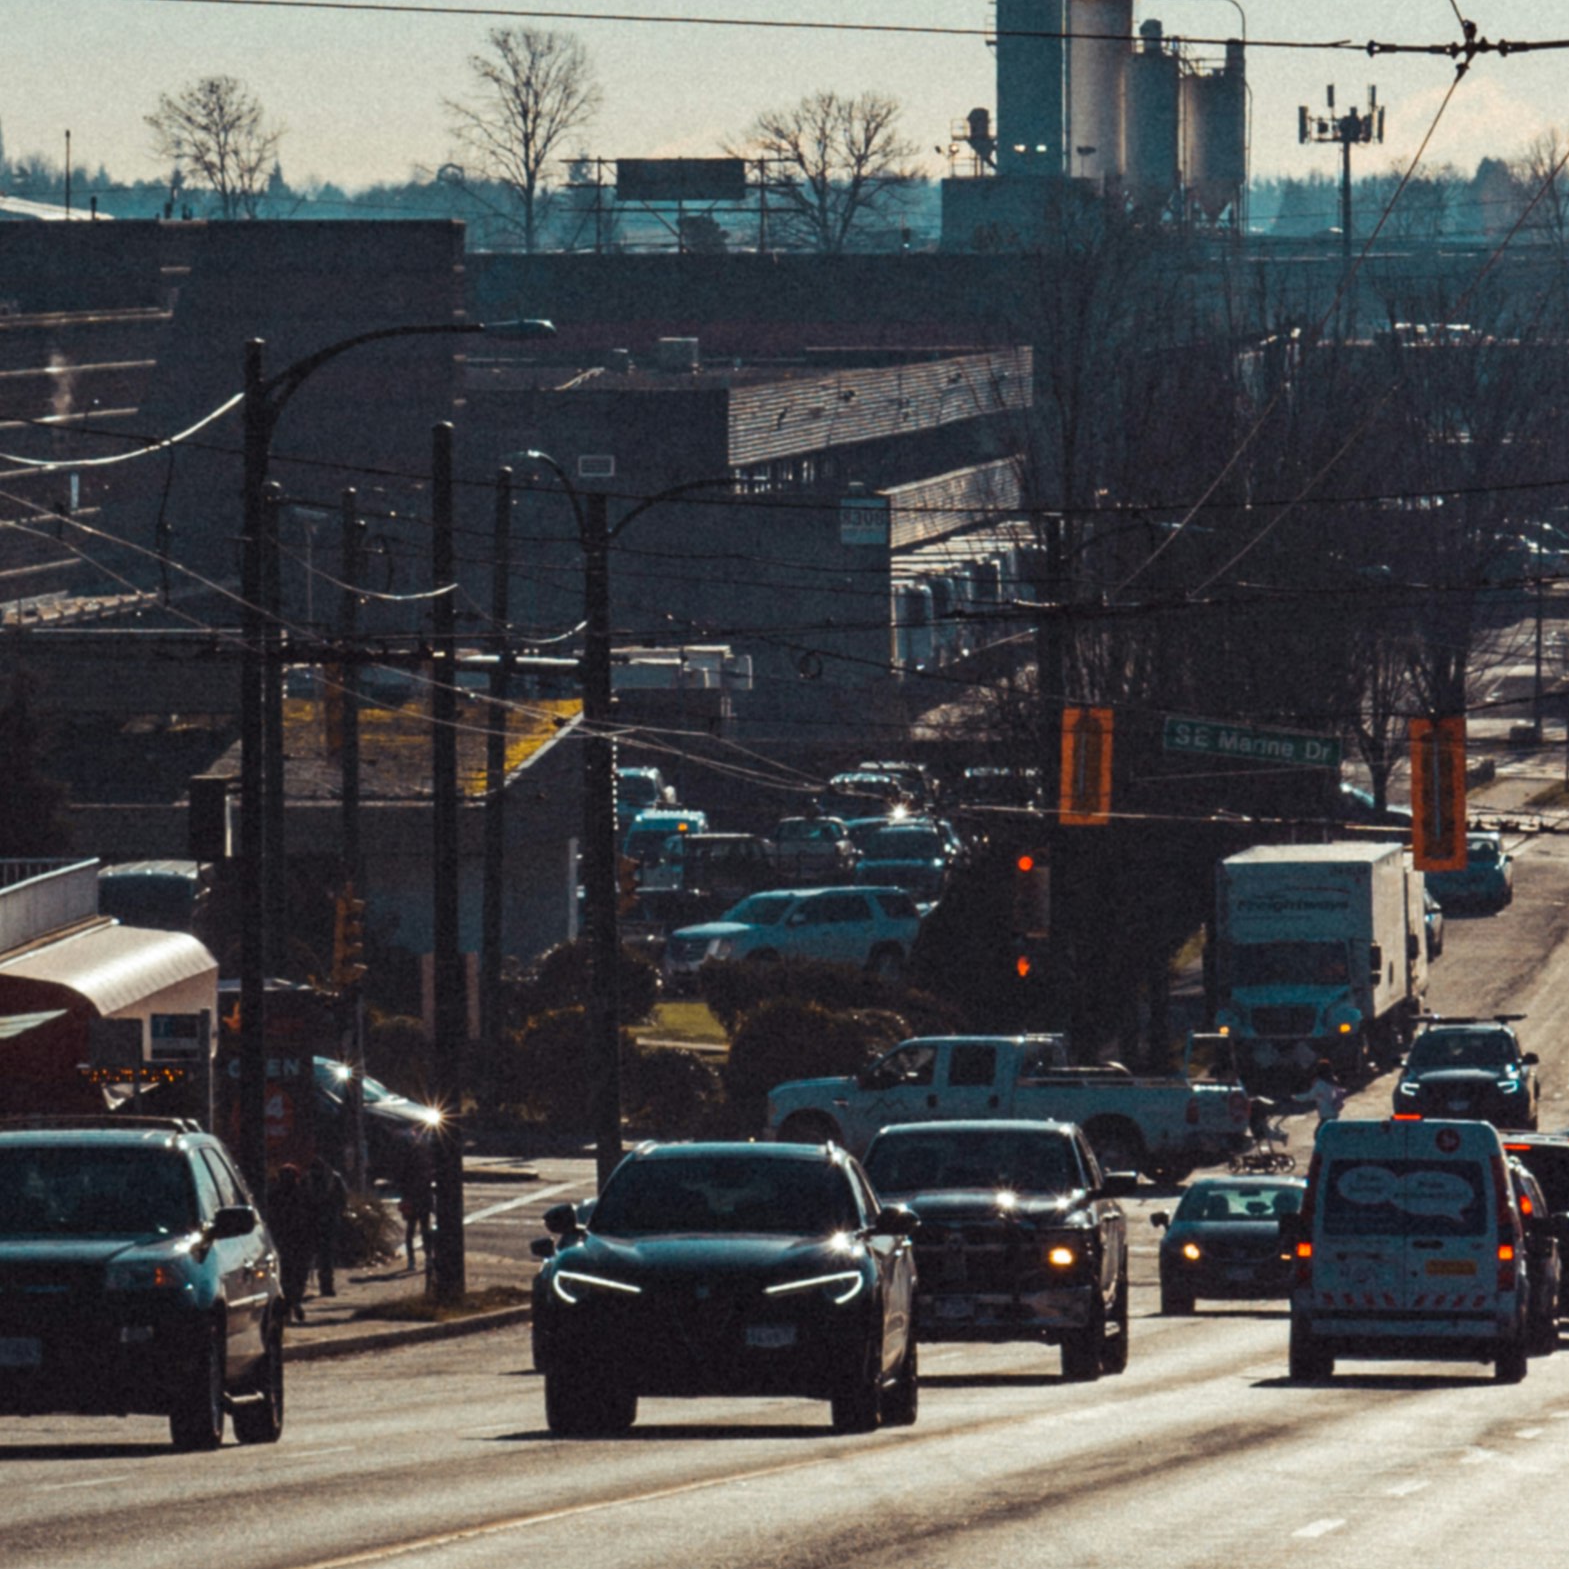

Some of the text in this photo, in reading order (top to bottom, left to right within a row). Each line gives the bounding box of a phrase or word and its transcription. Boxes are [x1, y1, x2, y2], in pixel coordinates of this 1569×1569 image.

[1174, 723, 1332, 761] SE Marine Dr
[228, 1058, 299, 1078] OEN
